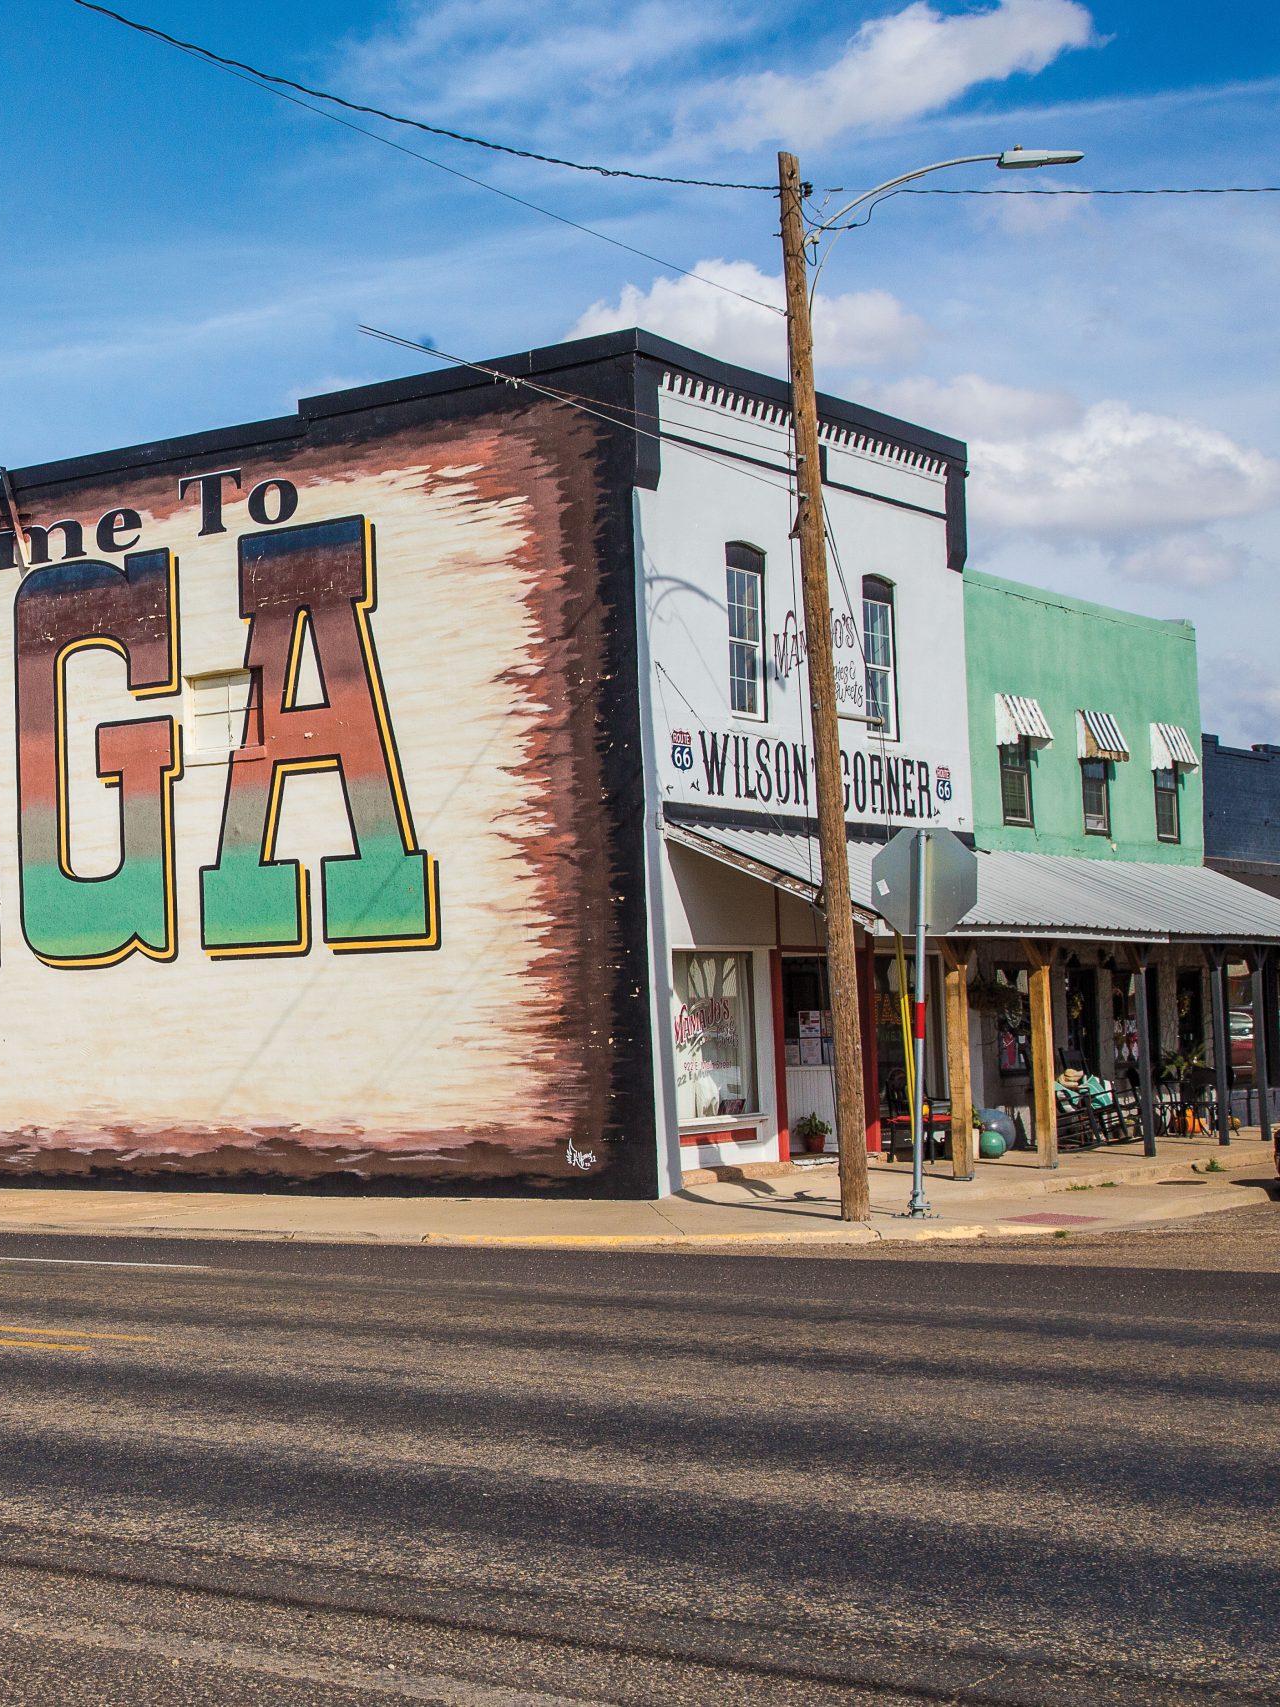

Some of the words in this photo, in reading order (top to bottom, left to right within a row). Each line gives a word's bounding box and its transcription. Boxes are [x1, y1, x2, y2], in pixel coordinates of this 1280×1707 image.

[178, 467, 298, 536] To
[773, 609, 809, 680] MA
[672, 732, 691, 744] ROUTE
[674, 746, 691, 767] 66
[698, 730, 815, 806] WILSON'
[938, 780, 951, 798] 66
[674, 1004, 706, 1044] MAMA
